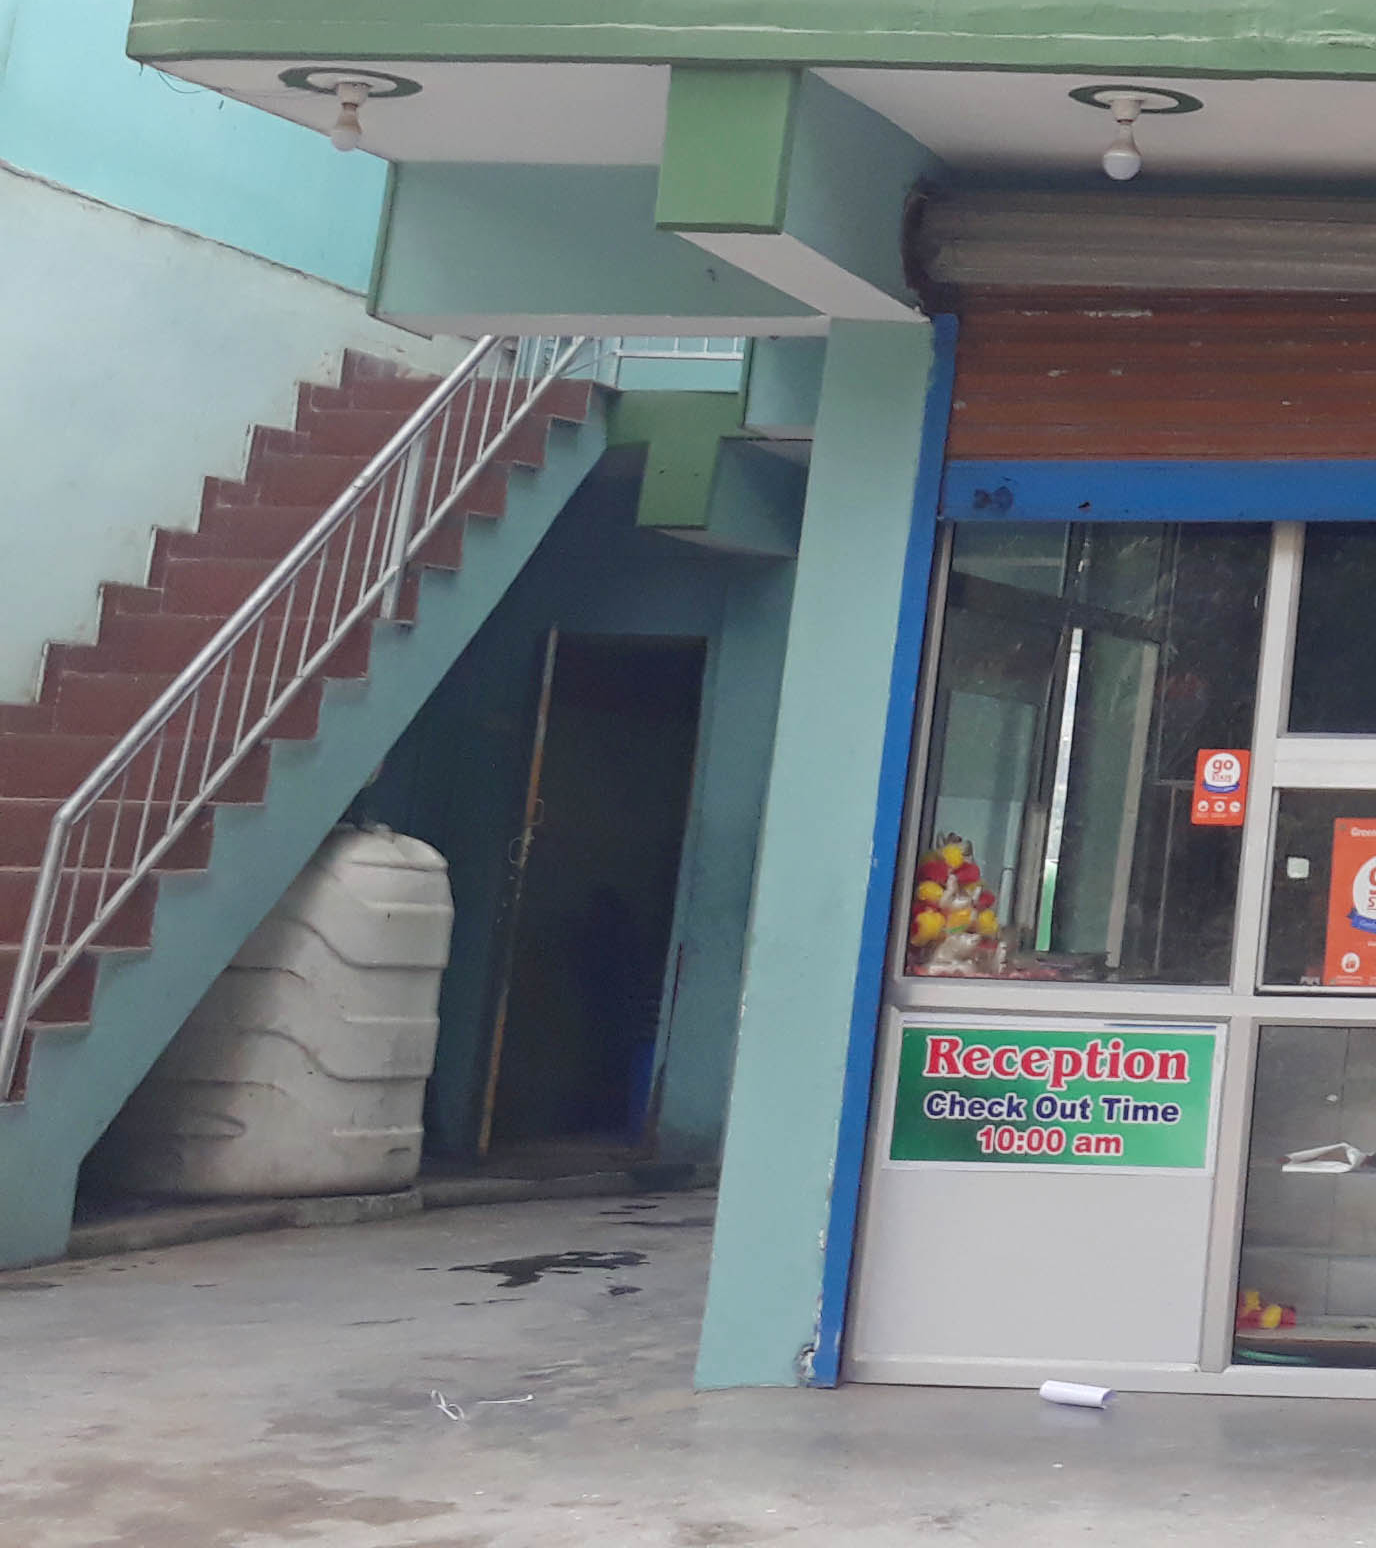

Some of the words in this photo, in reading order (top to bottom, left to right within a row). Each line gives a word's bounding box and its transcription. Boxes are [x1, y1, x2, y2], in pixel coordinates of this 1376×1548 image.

[1212, 759, 1234, 773] go
[924, 1036, 1189, 1089] Reception
[925, 1092, 1025, 1120] Check
[1035, 1094, 1091, 1121] Out
[1102, 1097, 1180, 1123] Time
[977, 1126, 1065, 1155] 10:00
[1074, 1134, 1123, 1155] am
